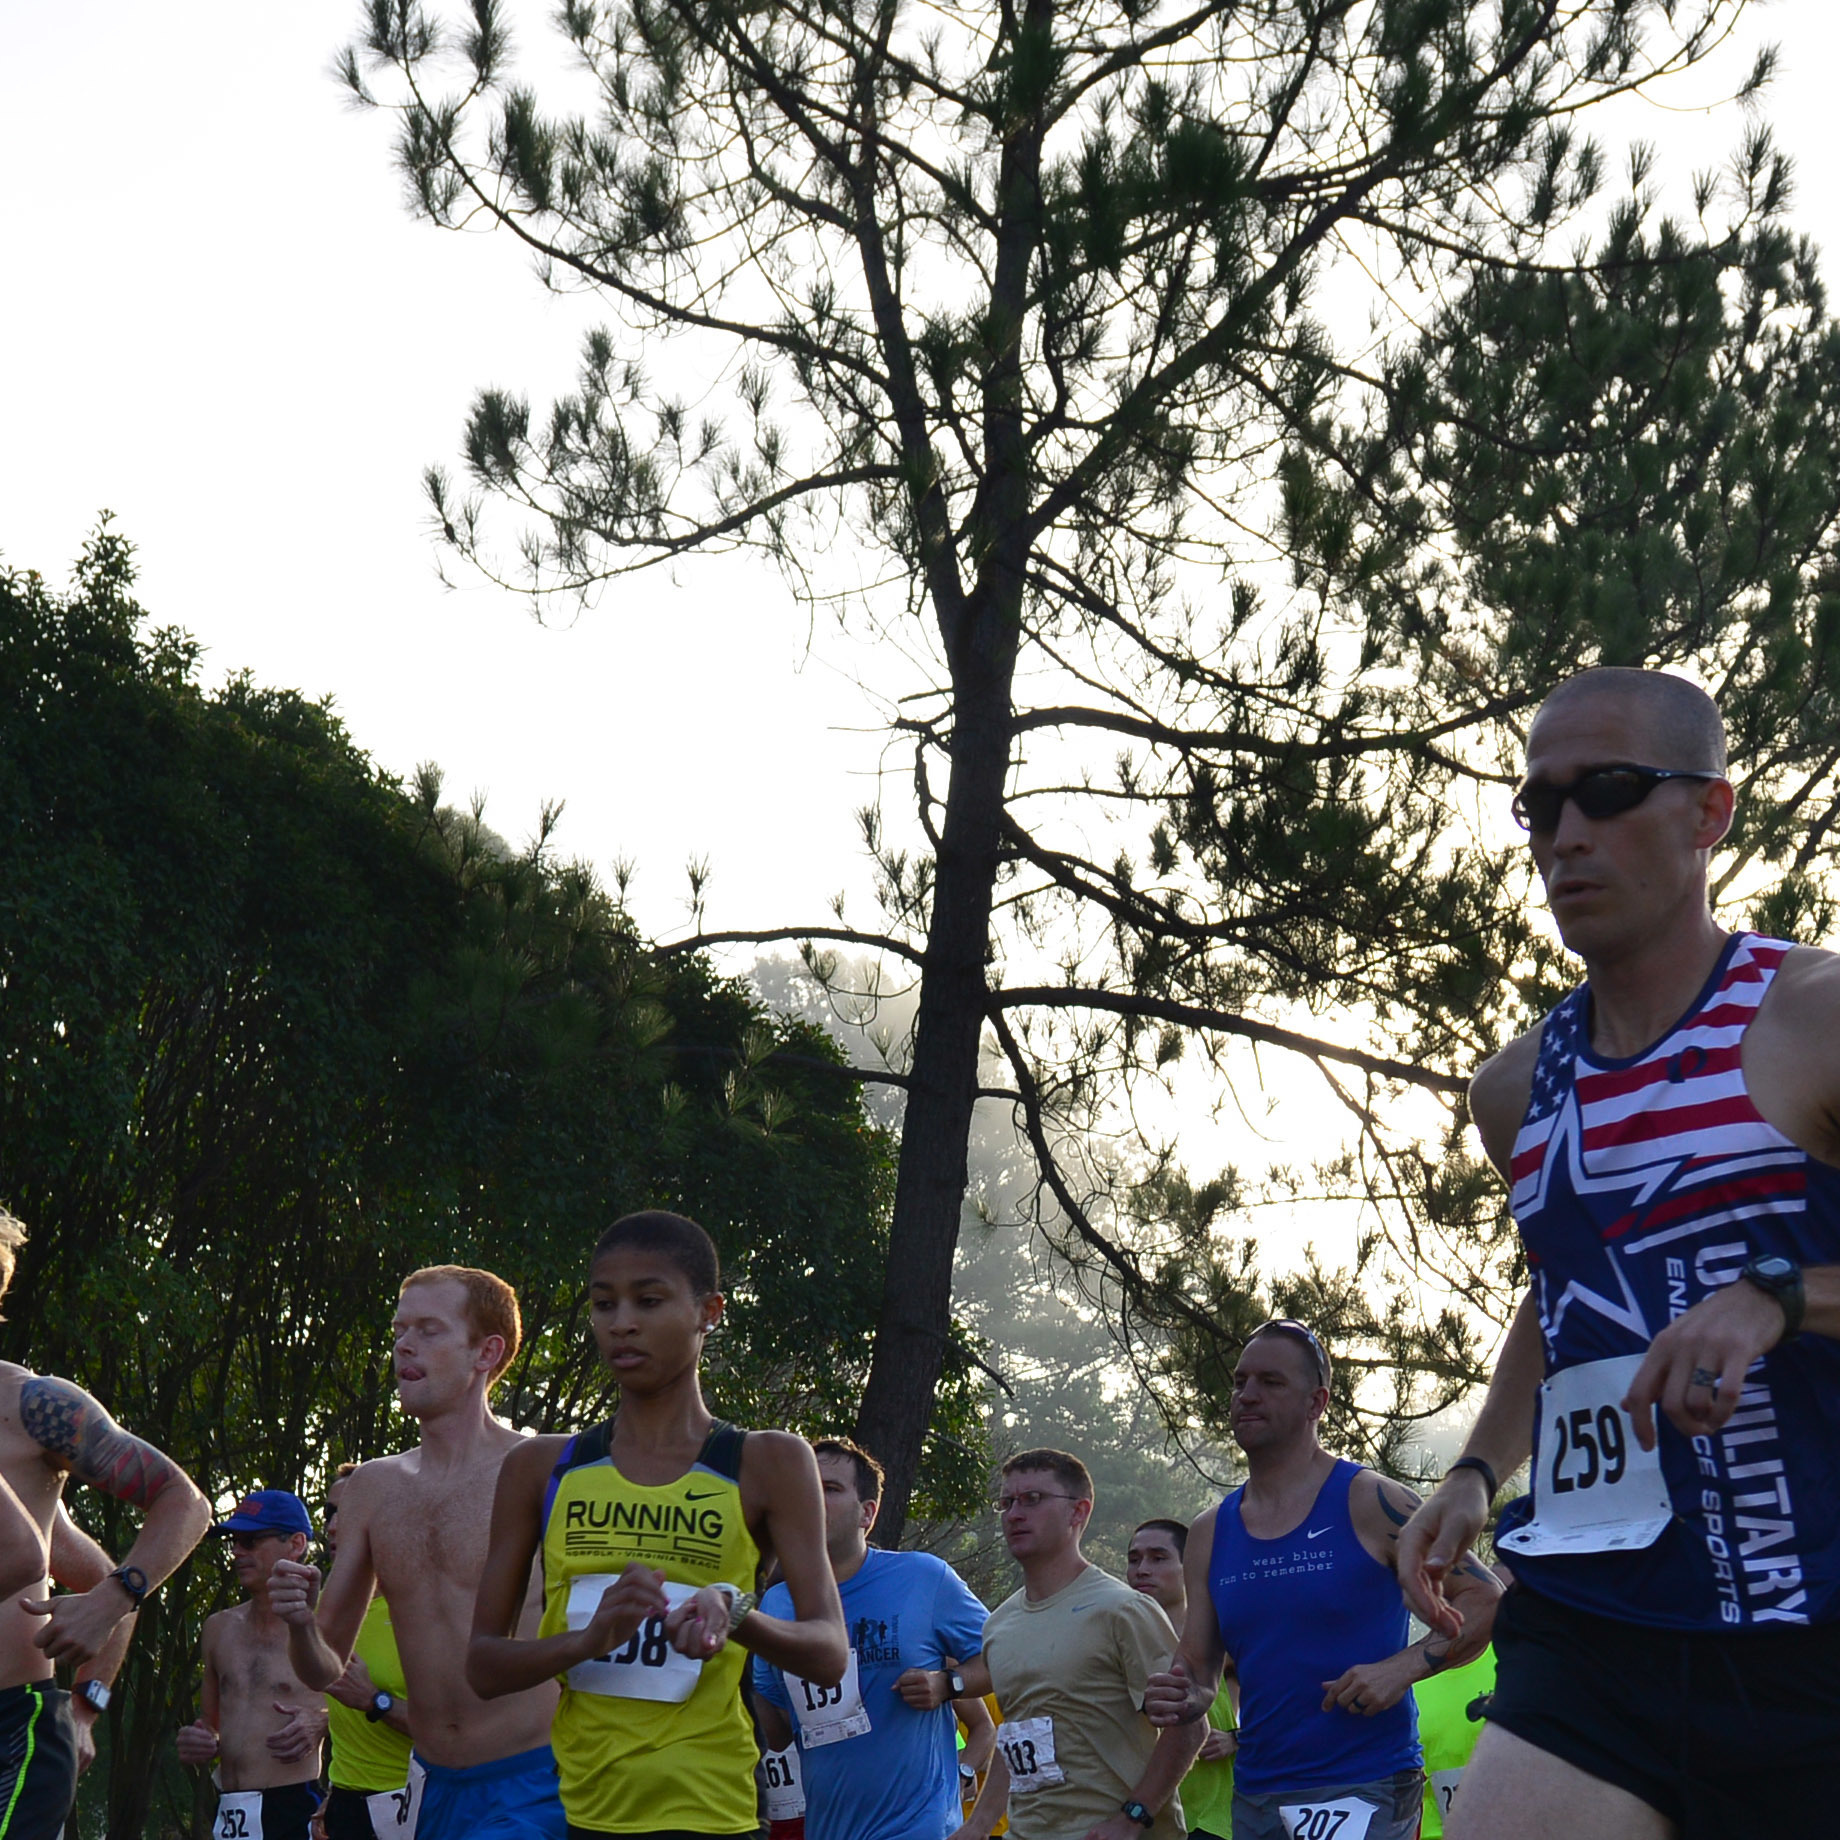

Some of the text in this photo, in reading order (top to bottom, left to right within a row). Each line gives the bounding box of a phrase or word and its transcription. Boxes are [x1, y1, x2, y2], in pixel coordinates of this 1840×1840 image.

[1552, 1405, 1626, 1494] 259
[566, 1500, 724, 1539] RUNNING
[565, 1530, 722, 1559] ETC
[1252, 1550, 1334, 1567] wear blue:
[1701, 1489, 1740, 1624] SPORTS
[1219, 1562, 1334, 1586] run to remember
[857, 1647, 900, 1665] ANCER
[764, 1755, 795, 1789] 61
[1004, 1740, 1037, 1776] 113
[221, 1809, 249, 1838] 252
